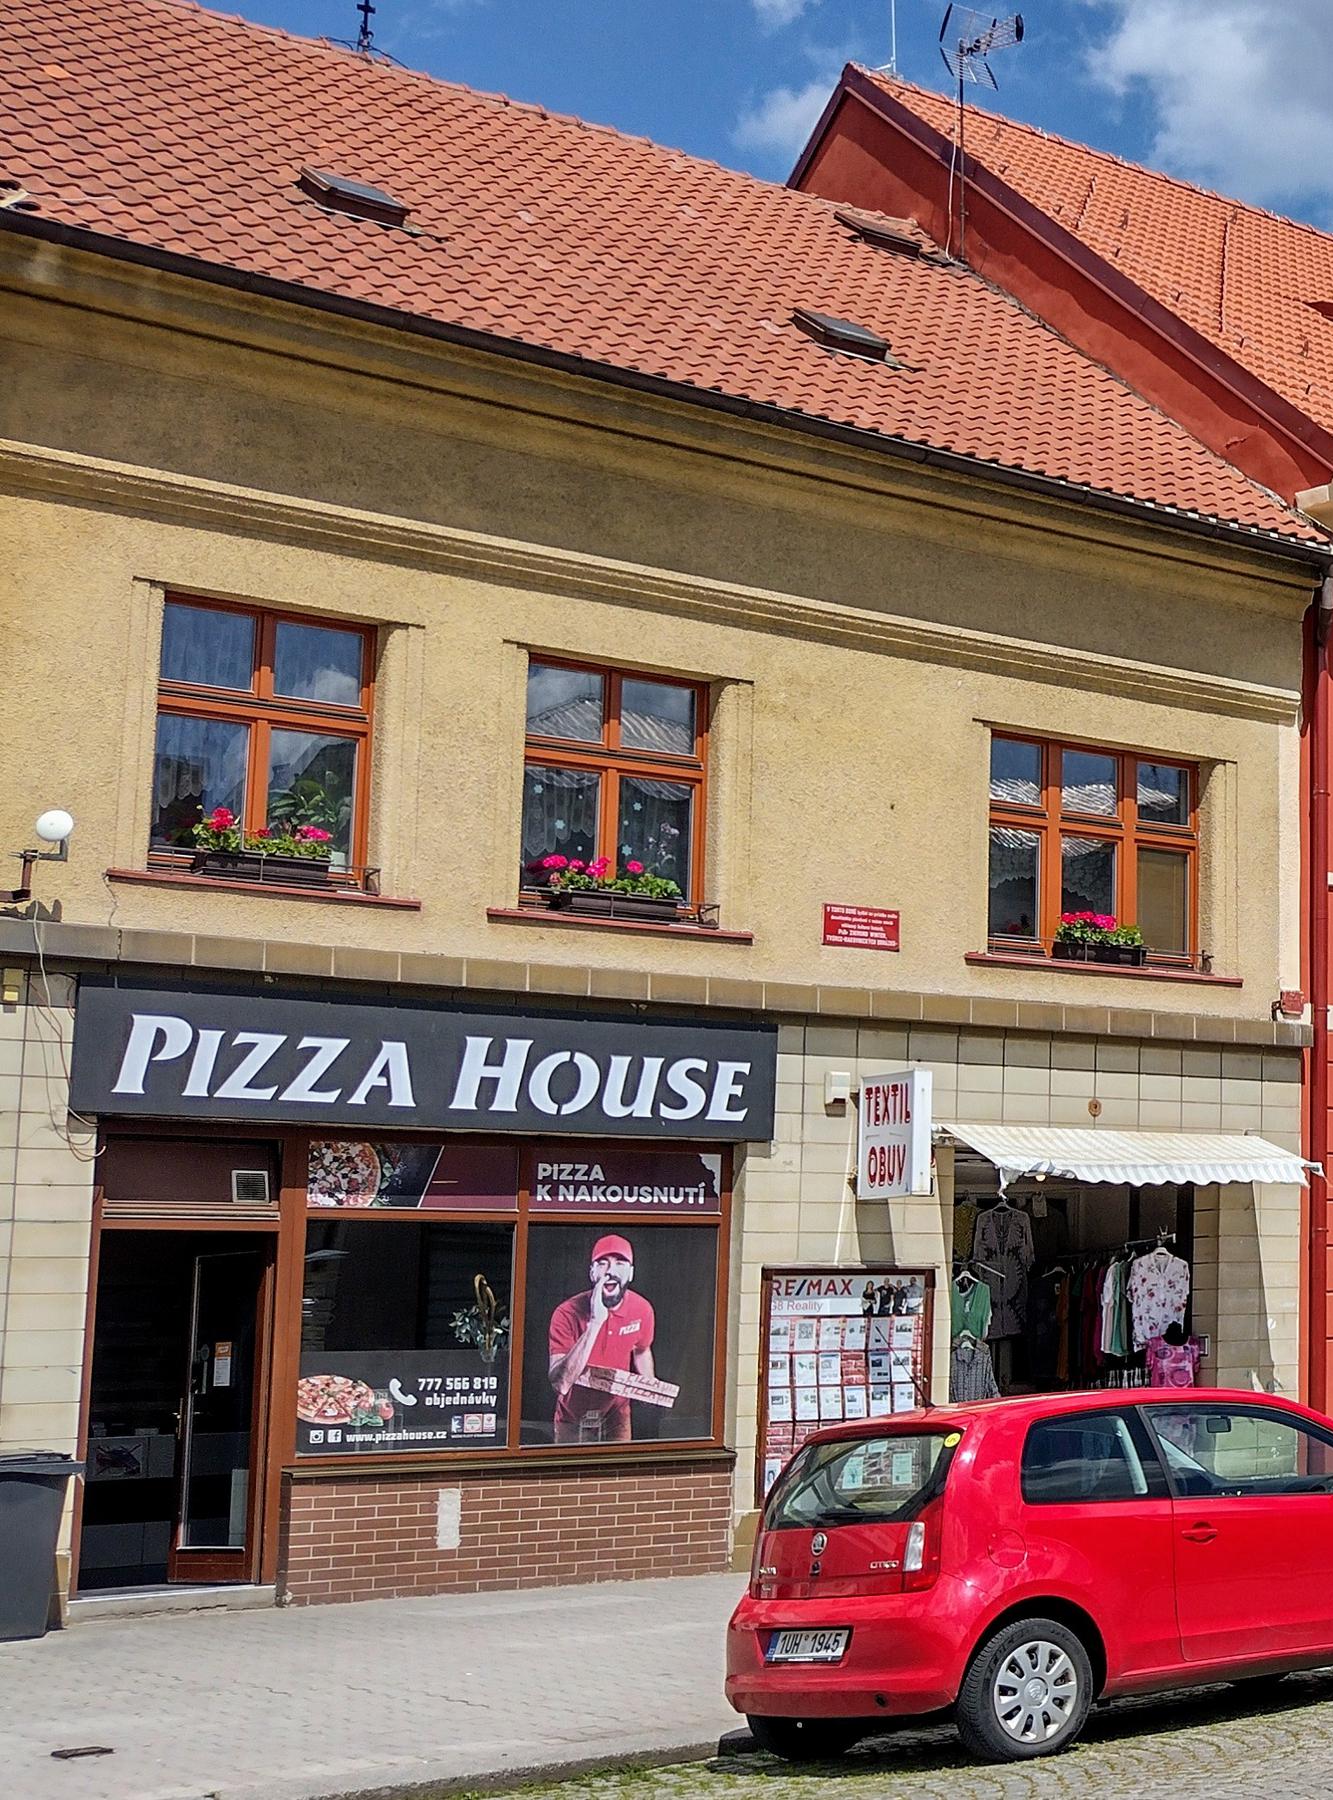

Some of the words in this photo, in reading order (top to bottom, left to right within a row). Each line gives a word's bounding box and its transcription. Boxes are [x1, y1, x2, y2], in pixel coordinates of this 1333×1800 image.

[110, 1013, 417, 1107] PIZZA
[448, 1036, 751, 1122] HOUSE
[865, 1082, 911, 1127] TEXTIL
[537, 1163, 605, 1181] PIZZA
[868, 1144, 906, 1188] OBUV
[537, 1185, 552, 1201] K
[558, 1181, 706, 1205] NAKOUSNUTÍ
[771, 1279, 854, 1297] RE/MAX
[786, 1300, 823, 1313] Reality
[418, 1377, 442, 1391] 777
[446, 1377, 470, 1391] 566
[473, 1376, 497, 1390] 819
[425, 1391, 497, 1408] objednávky
[346, 1429, 447, 1444] www.pizzahouse.cz
[779, 1633, 804, 1654] 1UH
[811, 1632, 843, 1653] 1945
